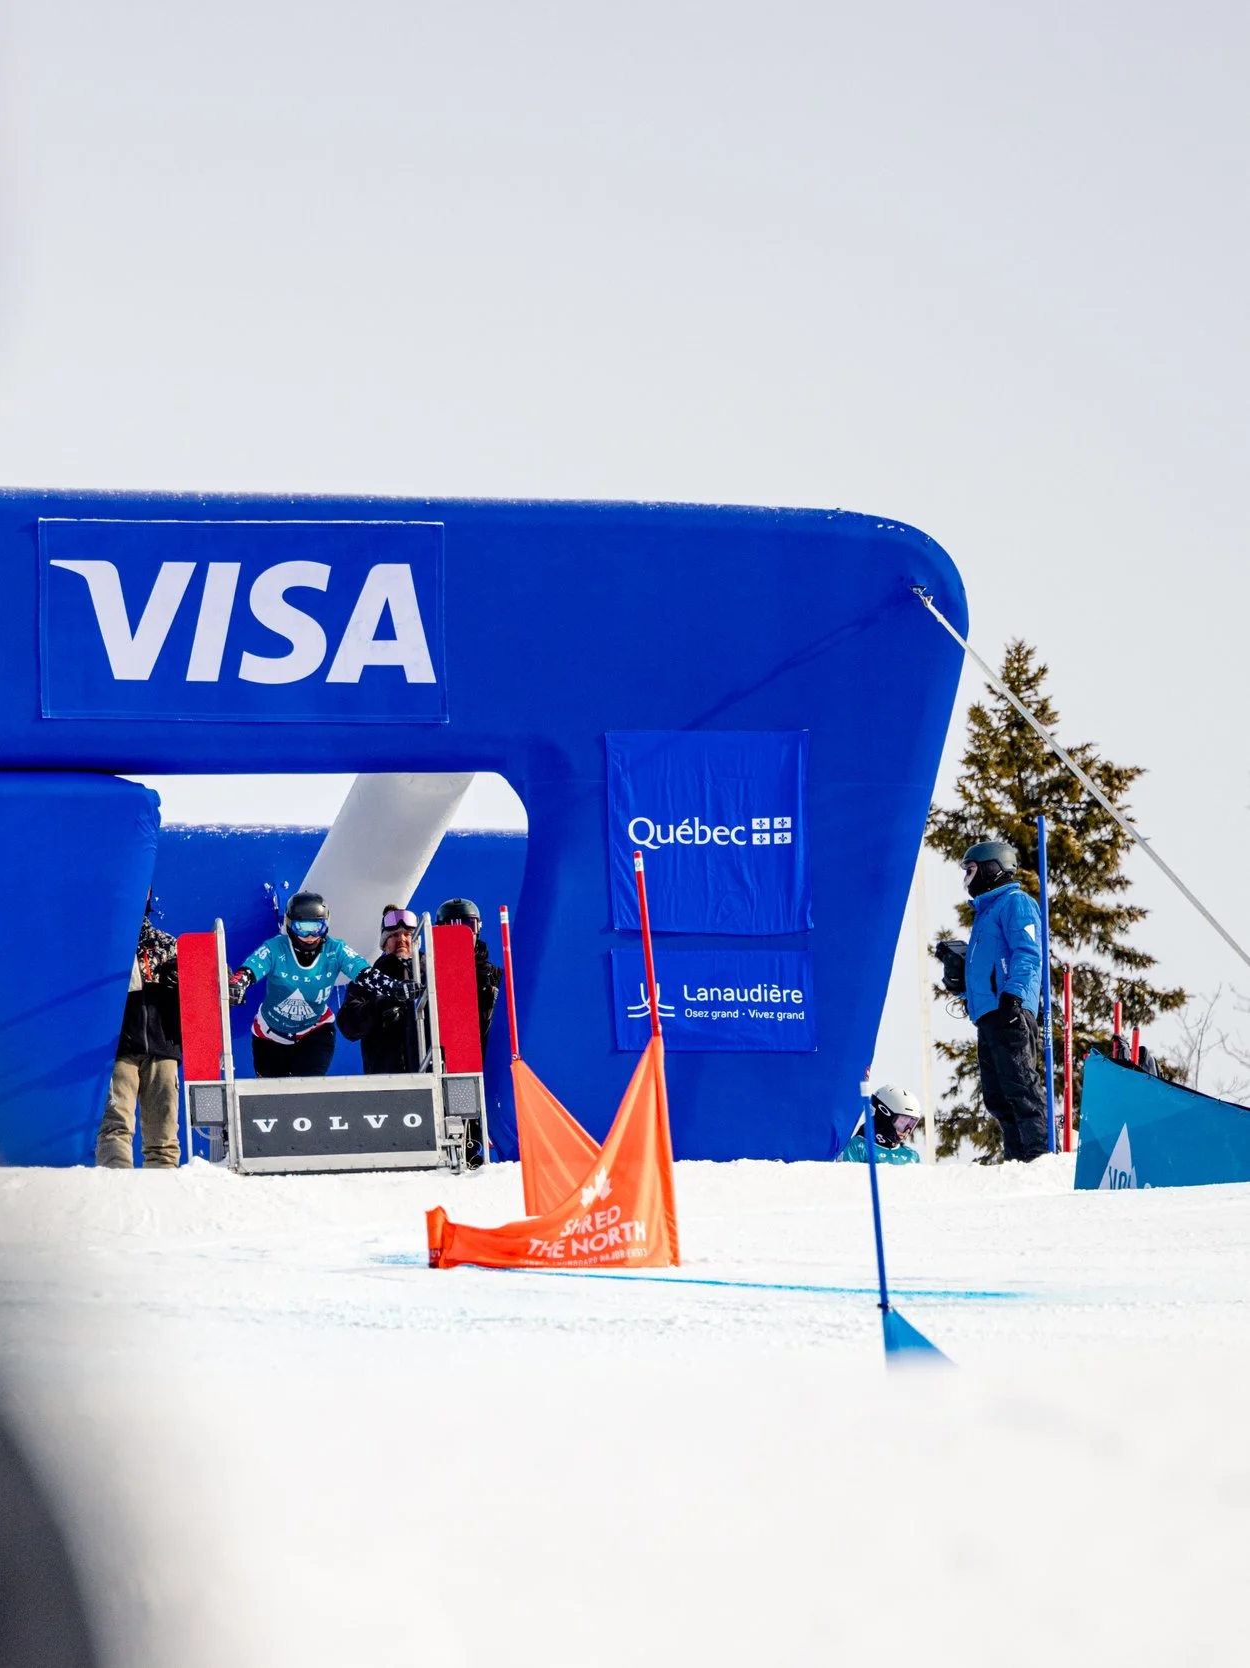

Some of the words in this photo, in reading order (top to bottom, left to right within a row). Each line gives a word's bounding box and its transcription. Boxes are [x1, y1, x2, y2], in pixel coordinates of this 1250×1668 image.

[50, 560, 437, 684] VISA
[628, 817, 747, 849] Québec
[281, 971, 332, 983] VOLVO
[683, 983, 803, 1004] Lanaudière
[685, 1008, 709, 1018] Osez
[711, 1009, 739, 1020] grand
[748, 1009, 774, 1018] Vivez
[777, 1011, 805, 1021] grand
[252, 1113, 423, 1133] VOLVO
[560, 1205, 621, 1237] SHRED
[527, 1238, 566, 1258] THE
[571, 1220, 647, 1256] NORTH
